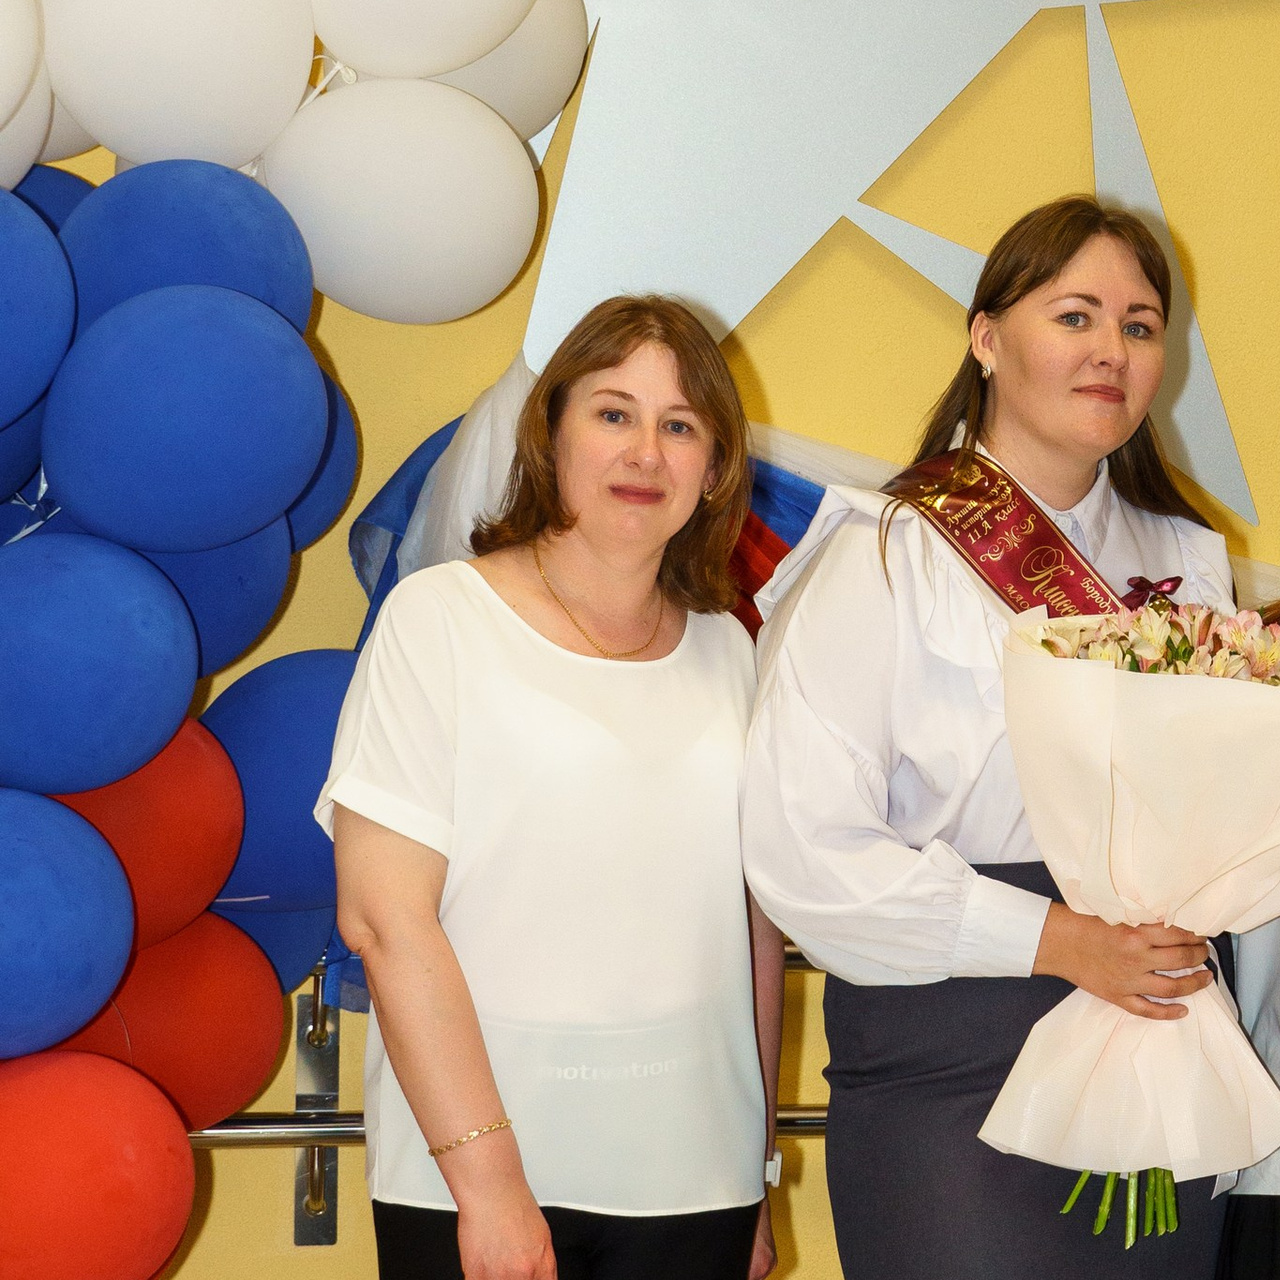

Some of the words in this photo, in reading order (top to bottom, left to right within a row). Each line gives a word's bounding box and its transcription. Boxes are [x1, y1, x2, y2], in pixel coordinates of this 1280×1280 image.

[961, 503, 992, 530] истории
[967, 529, 982, 545] 11
[1003, 583, 1031, 610] МАО
[1080, 577, 1117, 616] Бороду
